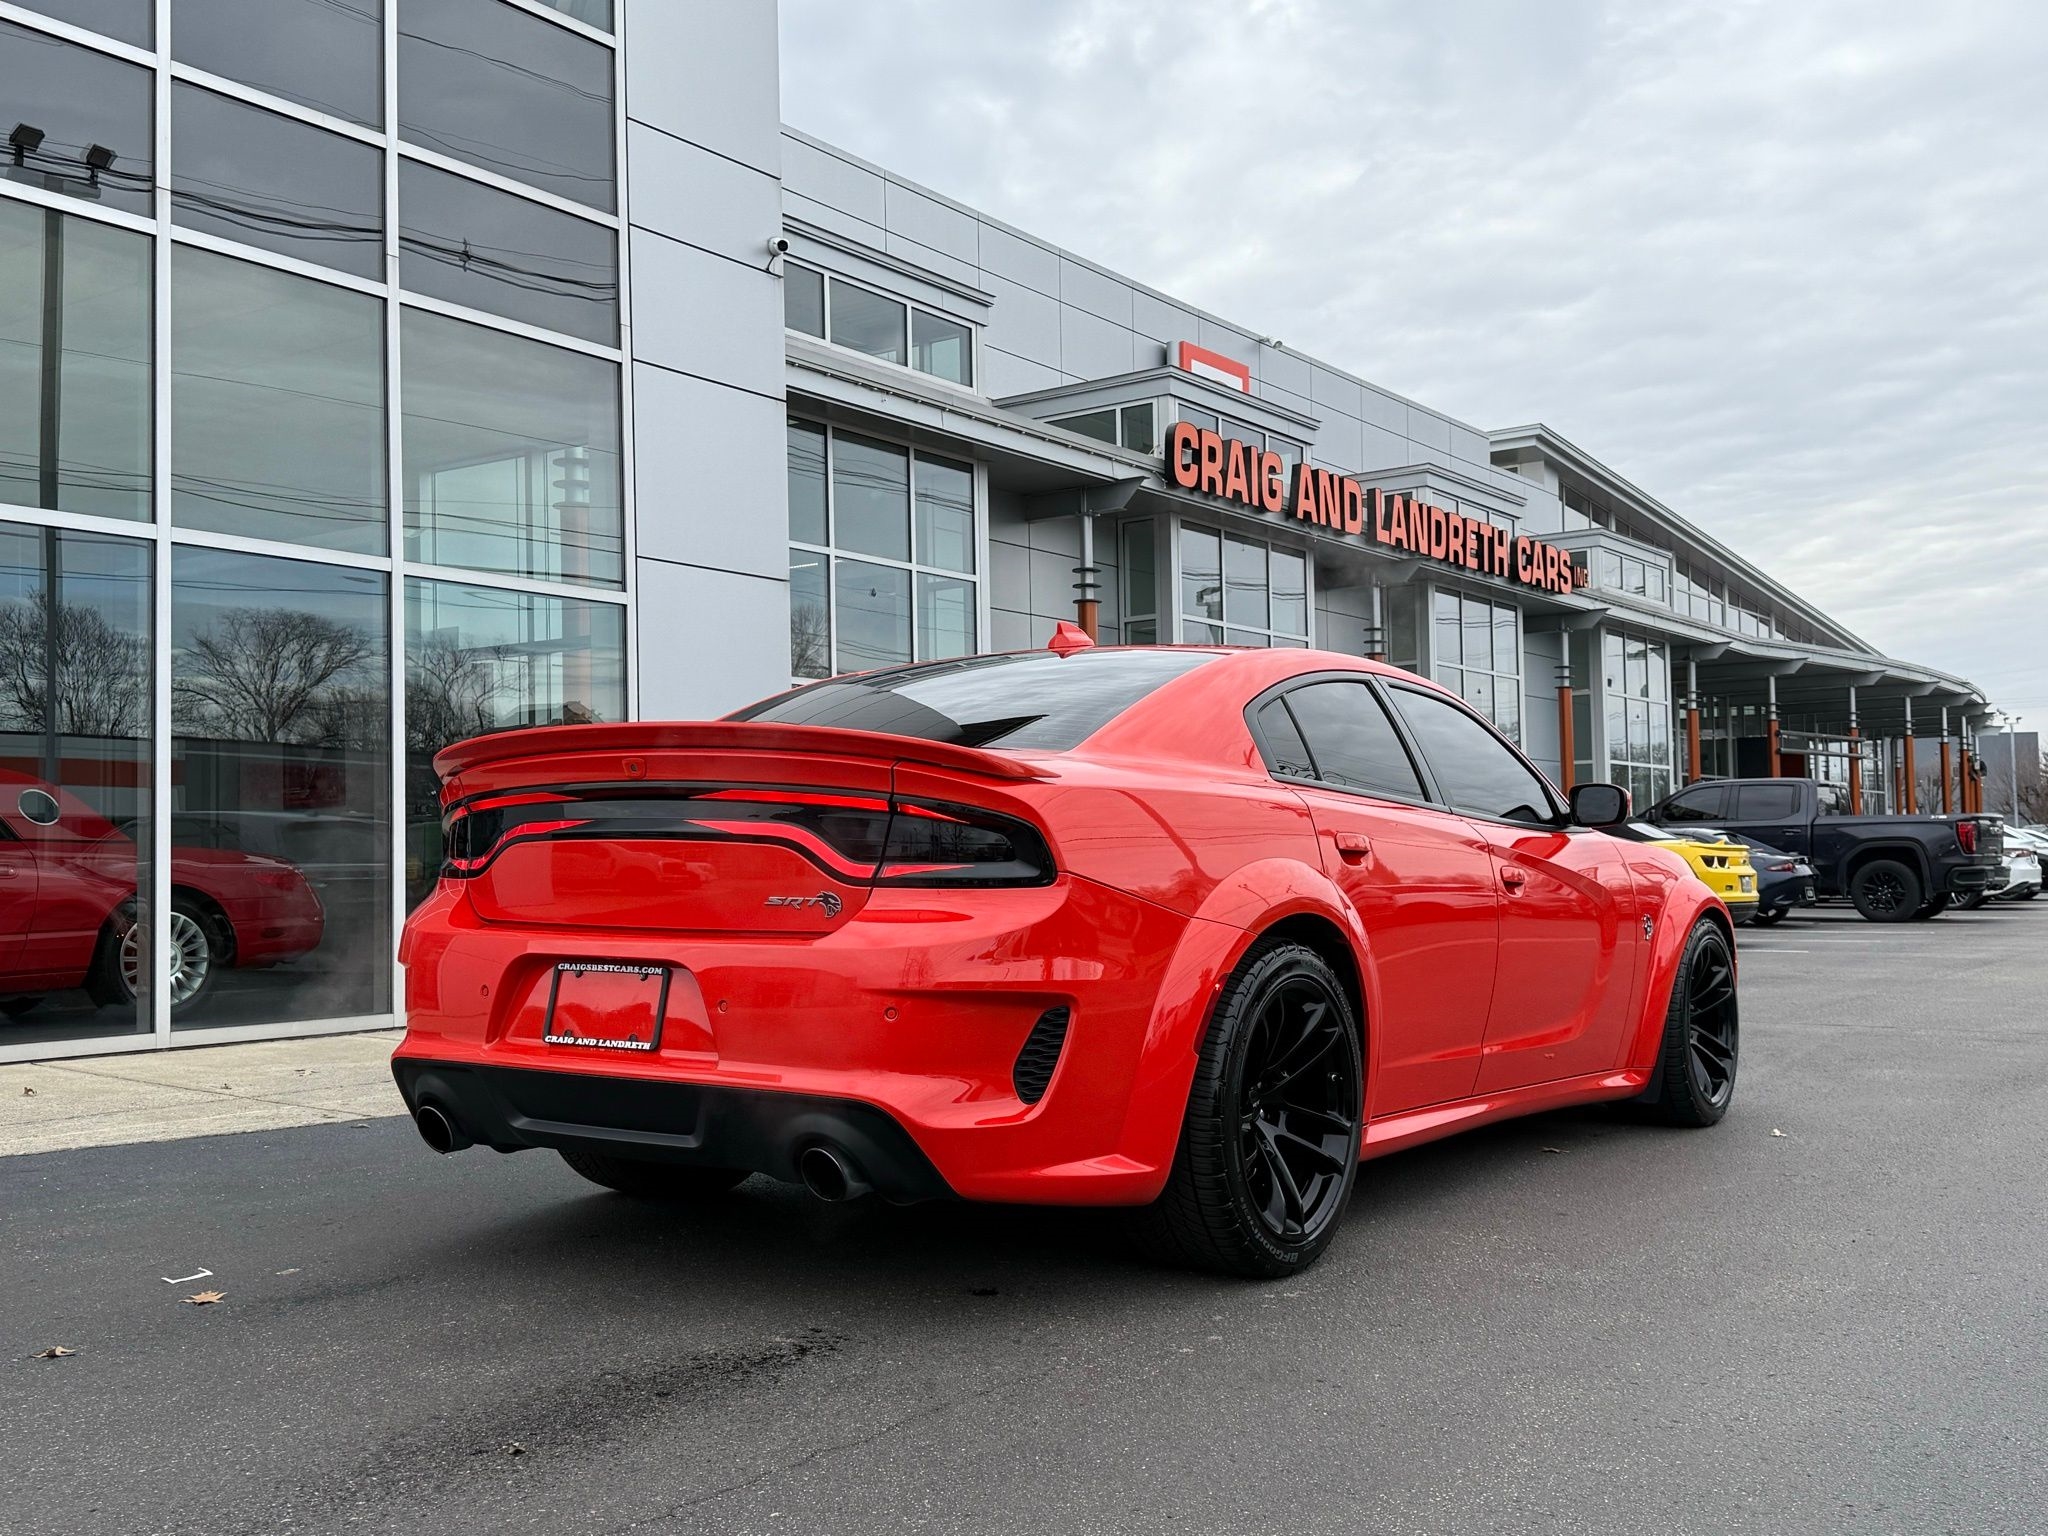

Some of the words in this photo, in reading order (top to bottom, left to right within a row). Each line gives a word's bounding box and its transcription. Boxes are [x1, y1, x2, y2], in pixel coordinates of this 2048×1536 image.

[1168, 421, 1284, 513] CRAIG
[1293, 463, 1363, 536] AND
[1371, 487, 1509, 578] LANDRETH
[1513, 535, 1572, 594] CARS
[764, 896, 824, 910] SRT
[557, 962, 663, 975] CRAIGSBESTCARS.COM
[544, 1035, 575, 1045] CRAIG
[575, 1037, 597, 1046] AND
[598, 1039, 652, 1050] LANDRETH
